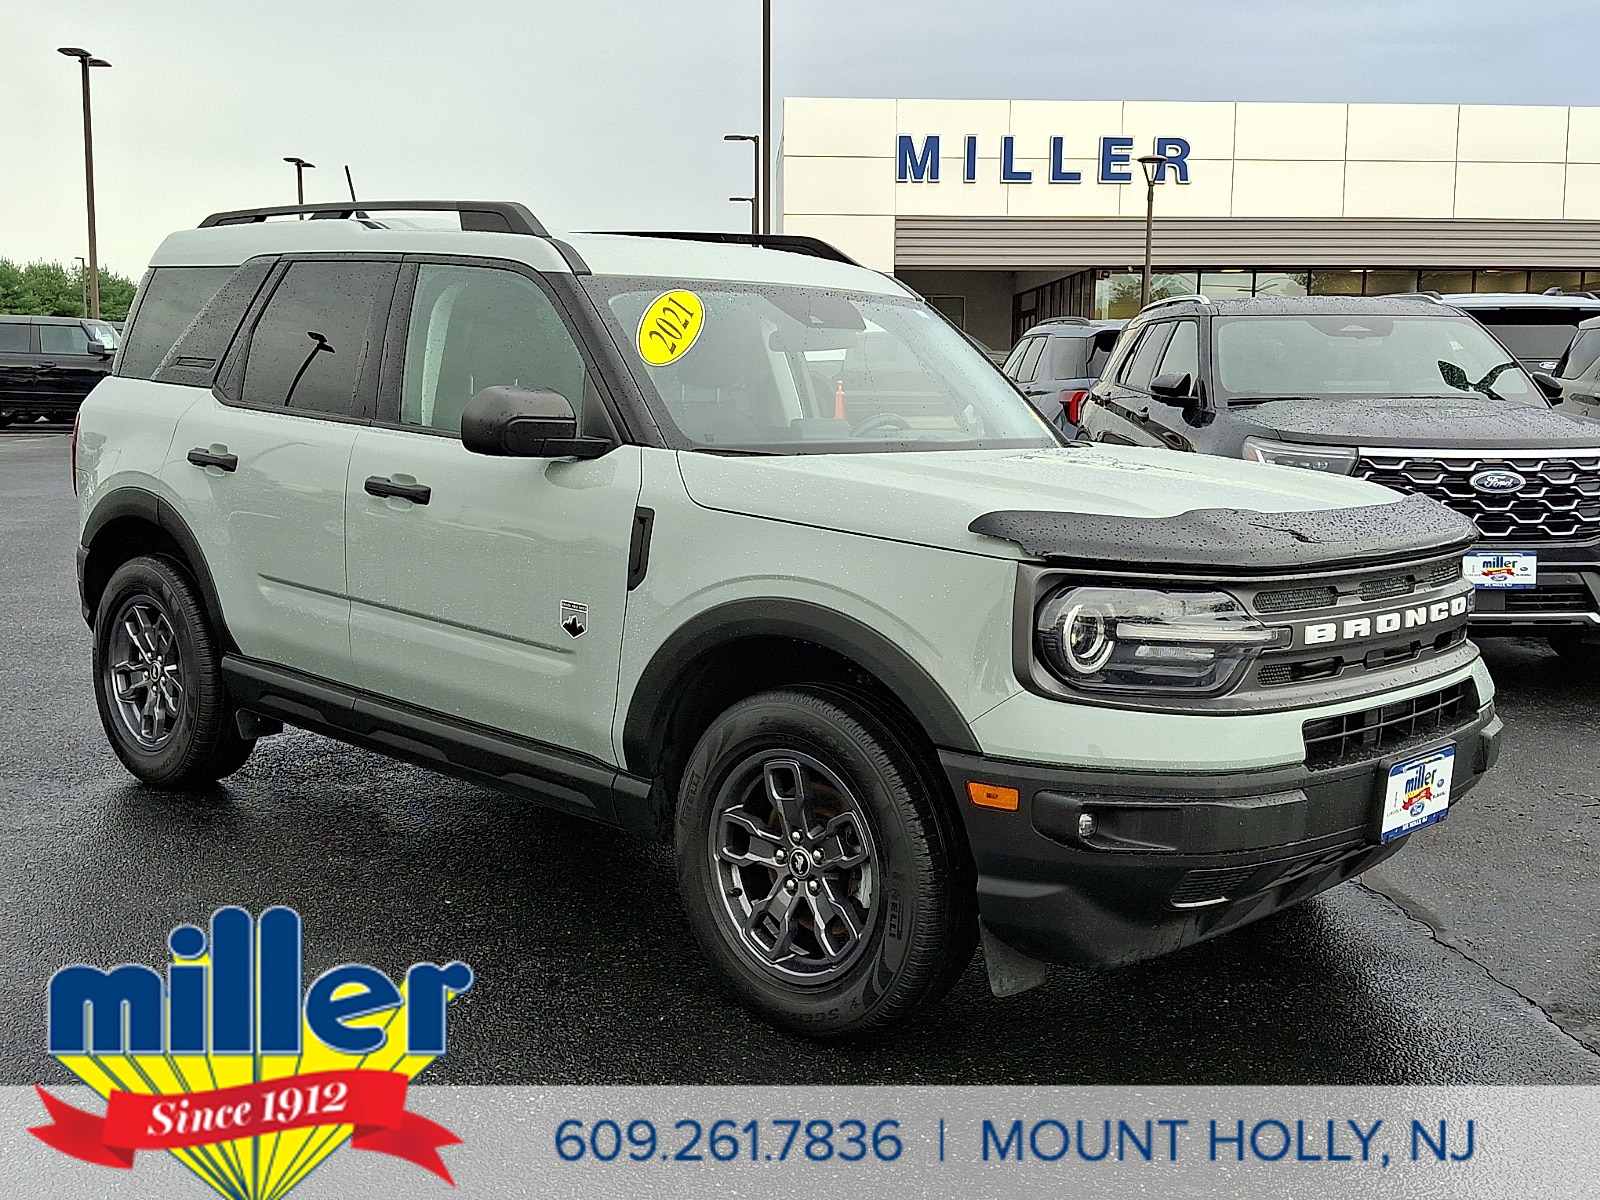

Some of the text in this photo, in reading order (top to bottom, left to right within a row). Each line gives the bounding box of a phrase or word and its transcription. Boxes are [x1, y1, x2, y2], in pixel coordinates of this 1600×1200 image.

[896, 133, 1192, 184] MILLER
[648, 296, 695, 355] 2021
[1483, 475, 1514, 488] Ford
[1482, 556, 1518, 569] miller
[1304, 596, 1467, 645] BRONCO
[1404, 763, 1438, 795] miller
